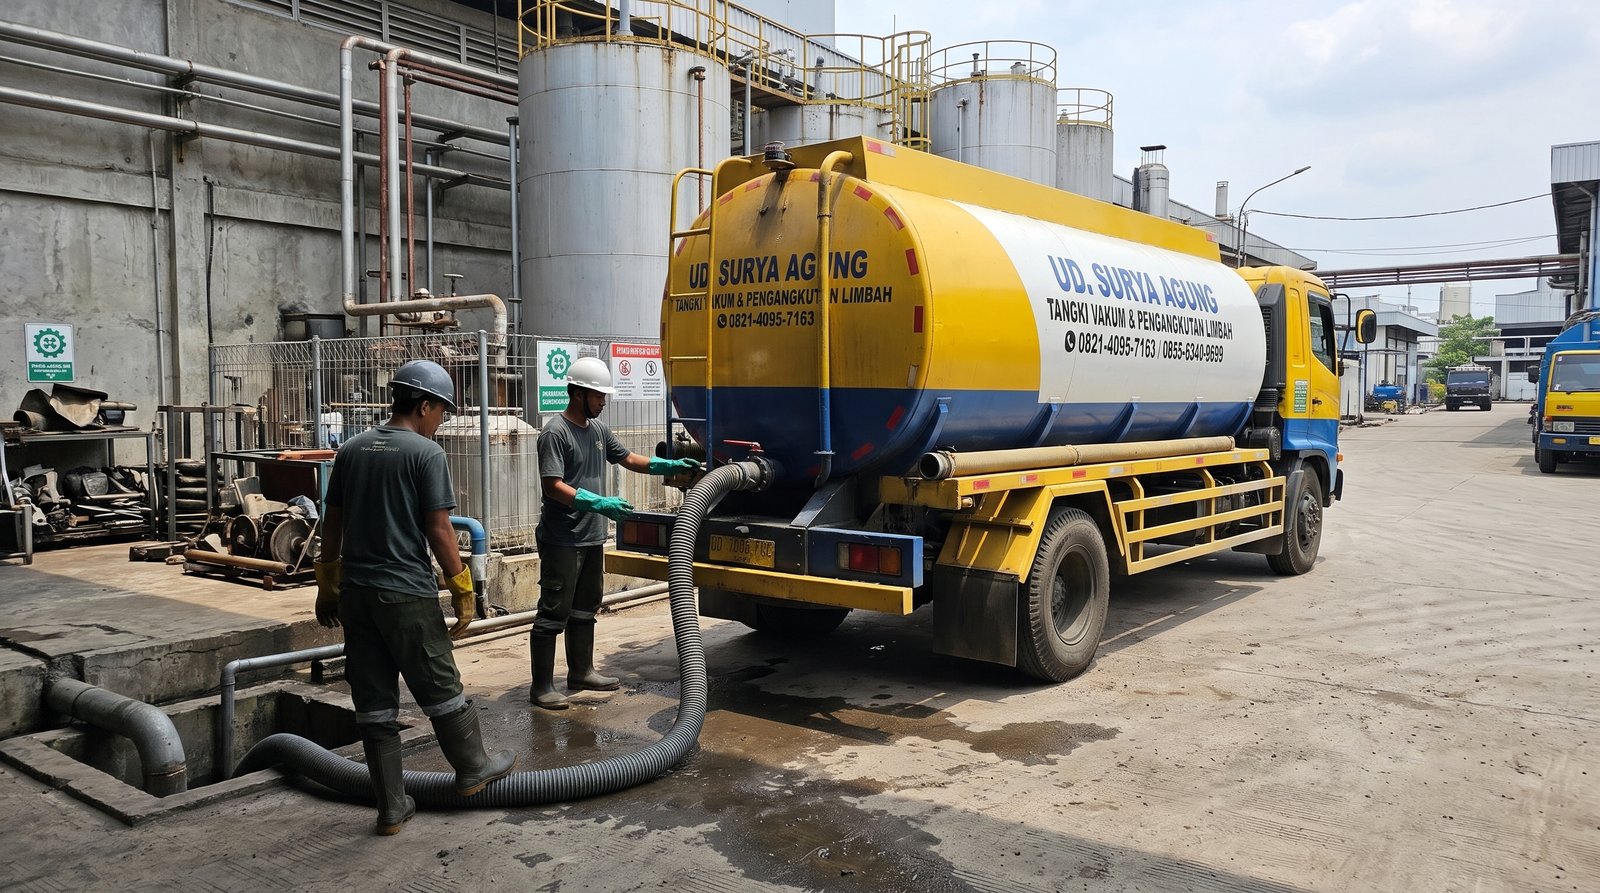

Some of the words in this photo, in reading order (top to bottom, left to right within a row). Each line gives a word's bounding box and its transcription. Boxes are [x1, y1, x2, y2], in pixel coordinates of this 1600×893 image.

[718, 255, 780, 286] SURYA
[1047, 255, 1094, 295] UD.
[1091, 263, 1160, 305] SURYA
[1159, 275, 1219, 314] AGUNG
[675, 297, 703, 313] TANGKI
[704, 293, 735, 310] KUM
[736, 292, 744, 307] &
[746, 287, 839, 307] PENGANGKUTN
[842, 286, 893, 304] LIMBAH
[729, 310, 815, 329] 0821-4095-7163
[1046, 298, 1089, 325] TANGKI
[1090, 303, 1126, 329] VAKUM
[1128, 309, 1136, 329] &
[1137, 310, 1205, 338] PENGANGKUTAN
[1206, 320, 1233, 340] LIMBAH
[1078, 332, 1156, 359] 0821-4095-7163
[1156, 340, 1162, 359] /
[1162, 340, 1224, 363] 0855-6340-9699
